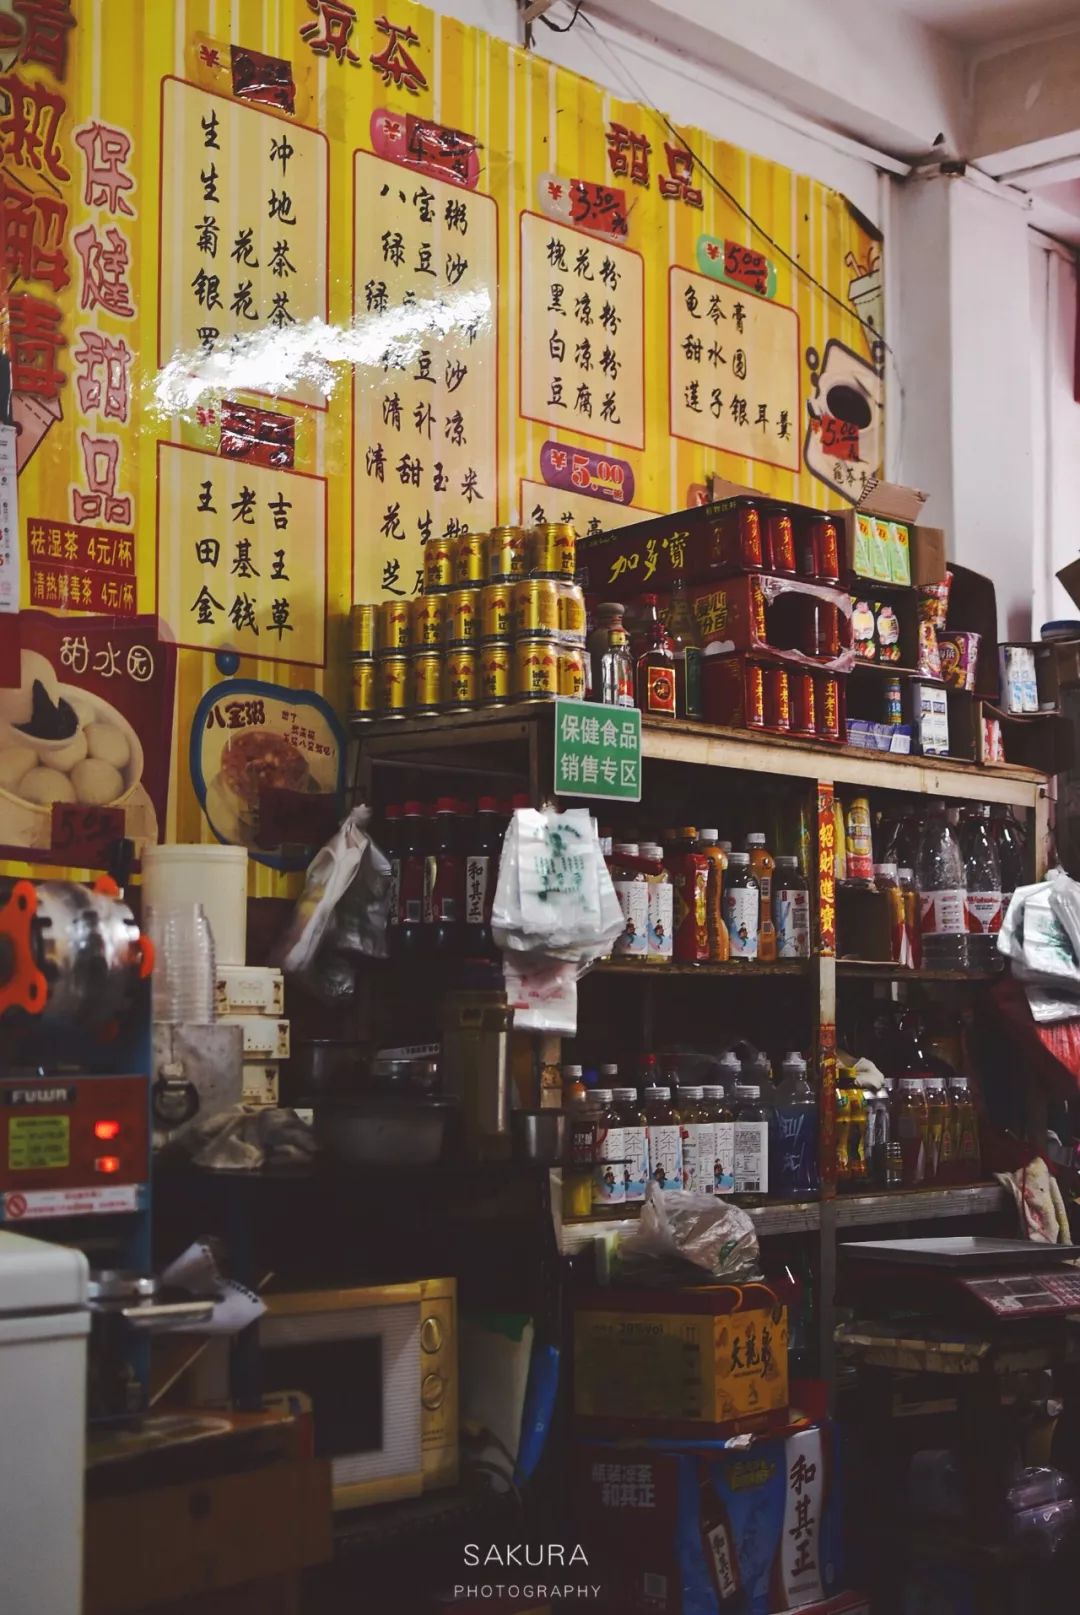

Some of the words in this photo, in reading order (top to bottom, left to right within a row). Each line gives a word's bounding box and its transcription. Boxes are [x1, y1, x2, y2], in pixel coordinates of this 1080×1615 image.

[605, 121, 704, 211] 甜品
[379, 184, 468, 236] 八宝粥
[193, 216, 298, 279] 菊花茶
[381, 231, 469, 286] 绿豆沙
[546, 238, 621, 292] 槐花粉
[72, 120, 136, 524] 保健甜品
[190, 267, 298, 330] 银花茶
[547, 284, 621, 335] 黑凉粉
[684, 285, 747, 334] 龟苓膏
[548, 330, 621, 381] 白凉粉
[380, 393, 467, 447] 清补凉
[547, 377, 621, 426] 豆腐花
[365, 442, 484, 504] 清甜玉米
[551, 448, 624, 491] ¥5.00
[196, 480, 293, 530] 王老吉
[31, 525, 79, 561] 祛湿茶
[87, 538, 133, 568] 4元/杯
[195, 538, 290, 582] 田基王
[608, 531, 690, 584] 加多寶
[33, 571, 93, 607] 清热解毒茶
[101, 580, 134, 612] 4元/杯
[190, 585, 294, 641] 金钱草
[206, 699, 265, 729] 八宝粥
[824, 680, 836, 729] 王老吉
[560, 713, 637, 749] 保健食品
[560, 753, 637, 787] 销售专区
[468, 862, 484, 917] 和其正
[601, 1483, 656, 1508] 和其正
[789, 1454, 817, 1577] 和其正
